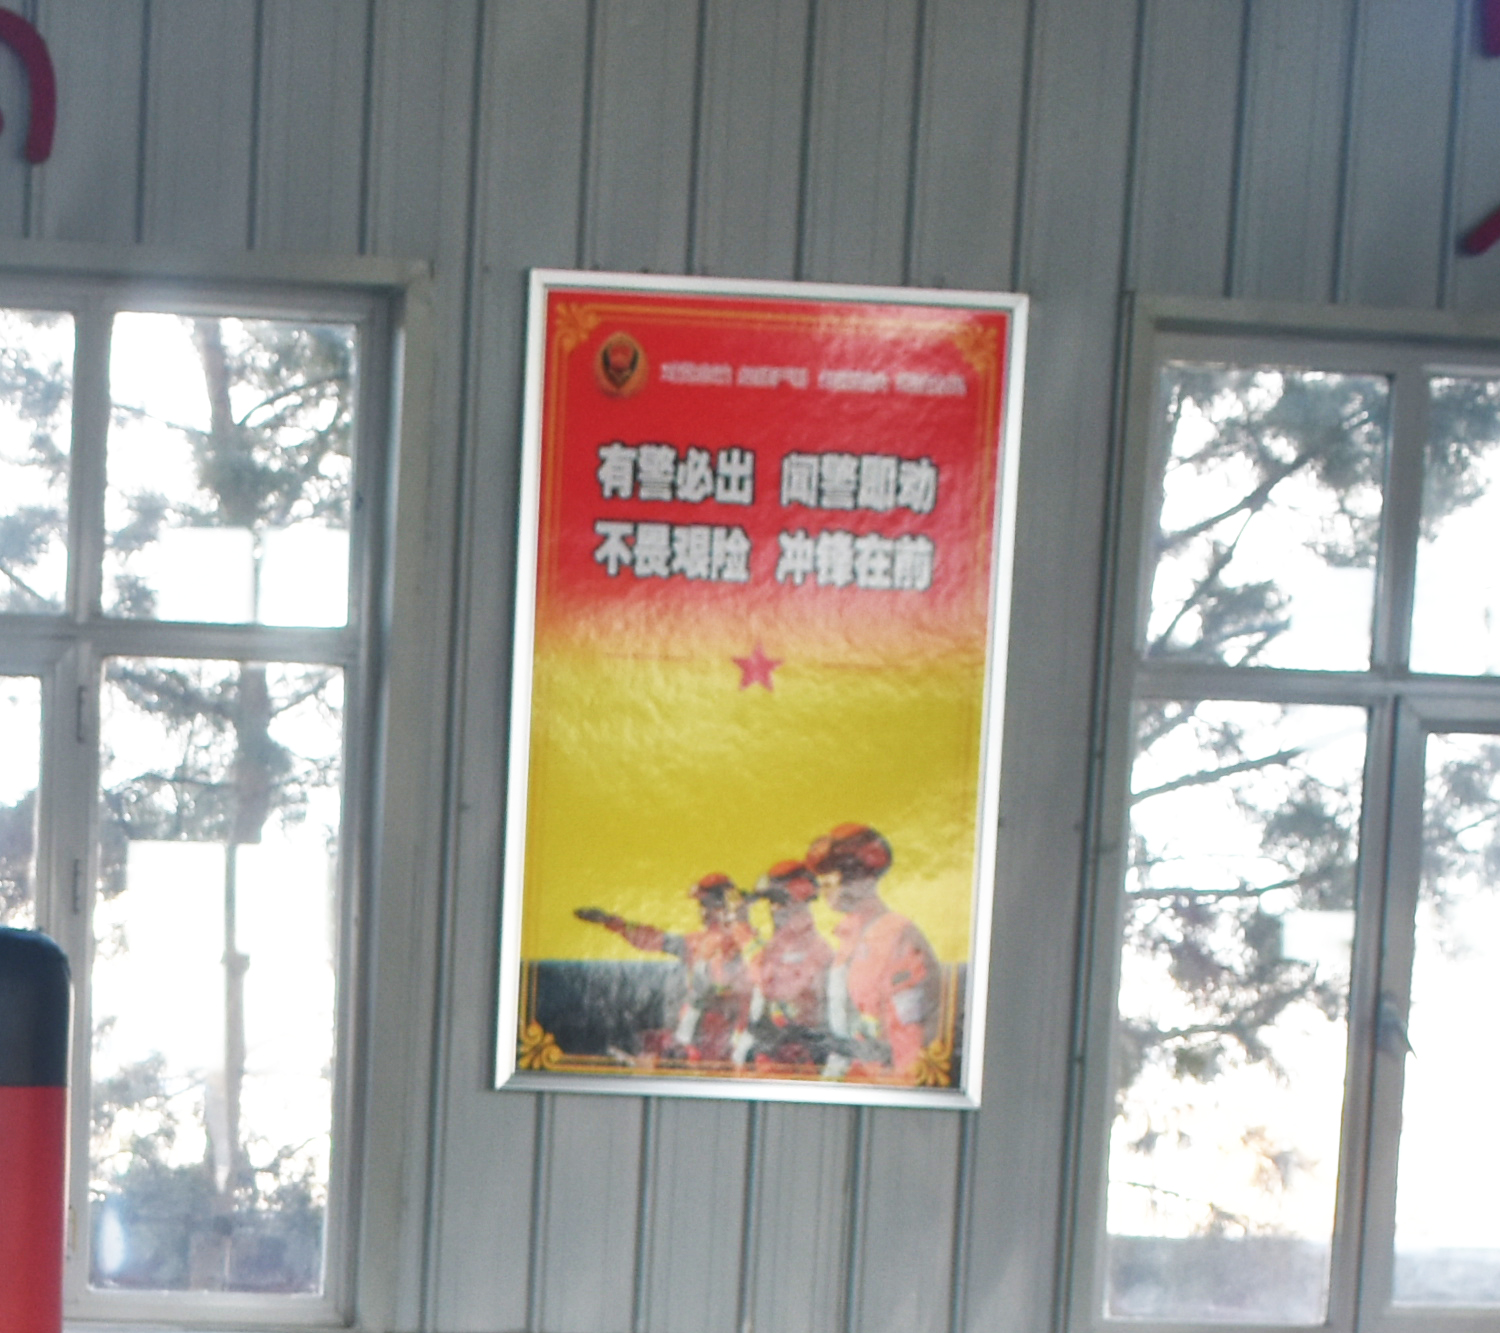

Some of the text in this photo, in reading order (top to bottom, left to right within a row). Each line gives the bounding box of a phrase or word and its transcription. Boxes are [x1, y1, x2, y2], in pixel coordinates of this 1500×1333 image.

[597, 441, 755, 506] 有警必出
[594, 519, 936, 592] 不畏艰险 冲锋在前
